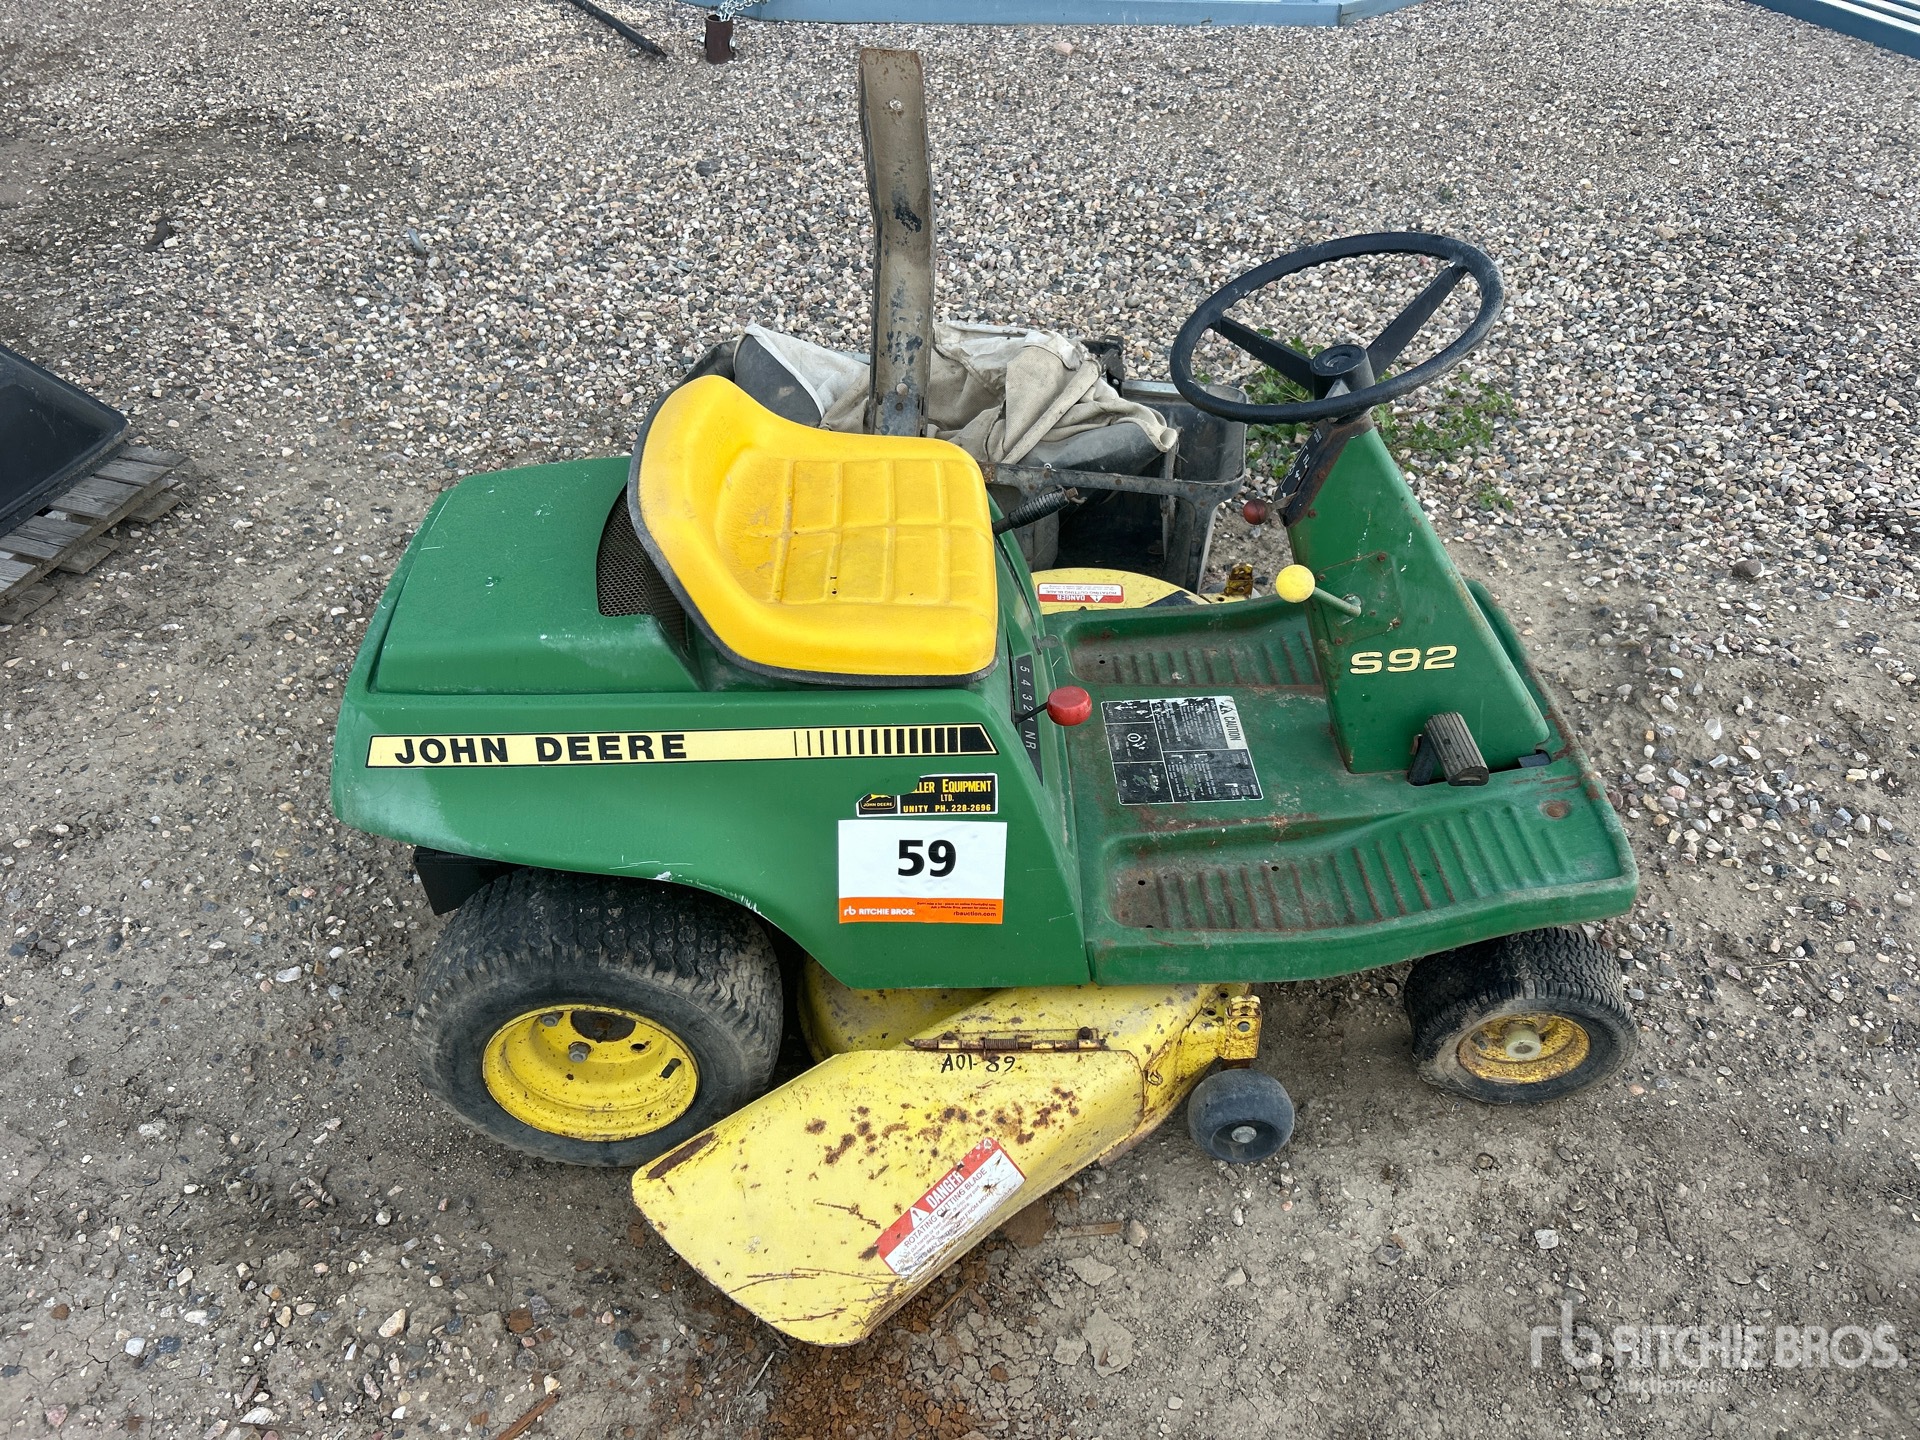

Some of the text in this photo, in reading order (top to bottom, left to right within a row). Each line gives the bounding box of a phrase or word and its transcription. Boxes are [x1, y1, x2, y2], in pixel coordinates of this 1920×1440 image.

[1350, 645, 1457, 675] S92
[1020, 665, 1030, 673] 5
[1021, 679, 1031, 687] 4
[1022, 693, 1032, 701] 3
[1223, 716, 1241, 741] CAUTION
[395, 734, 686, 764] JOHN DEERE
[1025, 741, 1036, 750] R
[940, 794, 954, 802] LTD.
[903, 805, 929, 813] UNITY
[935, 804, 949, 812] PH.
[898, 839, 956, 877] 59
[858, 908, 889, 916] RITCHIE
[890, 908, 916, 916] BROS.
[924, 1169, 965, 1209] DANGER
[903, 1215, 938, 1248] ROTATING
[935, 1188, 967, 1218] CUTTING
[963, 1168, 988, 1191] BLADE
